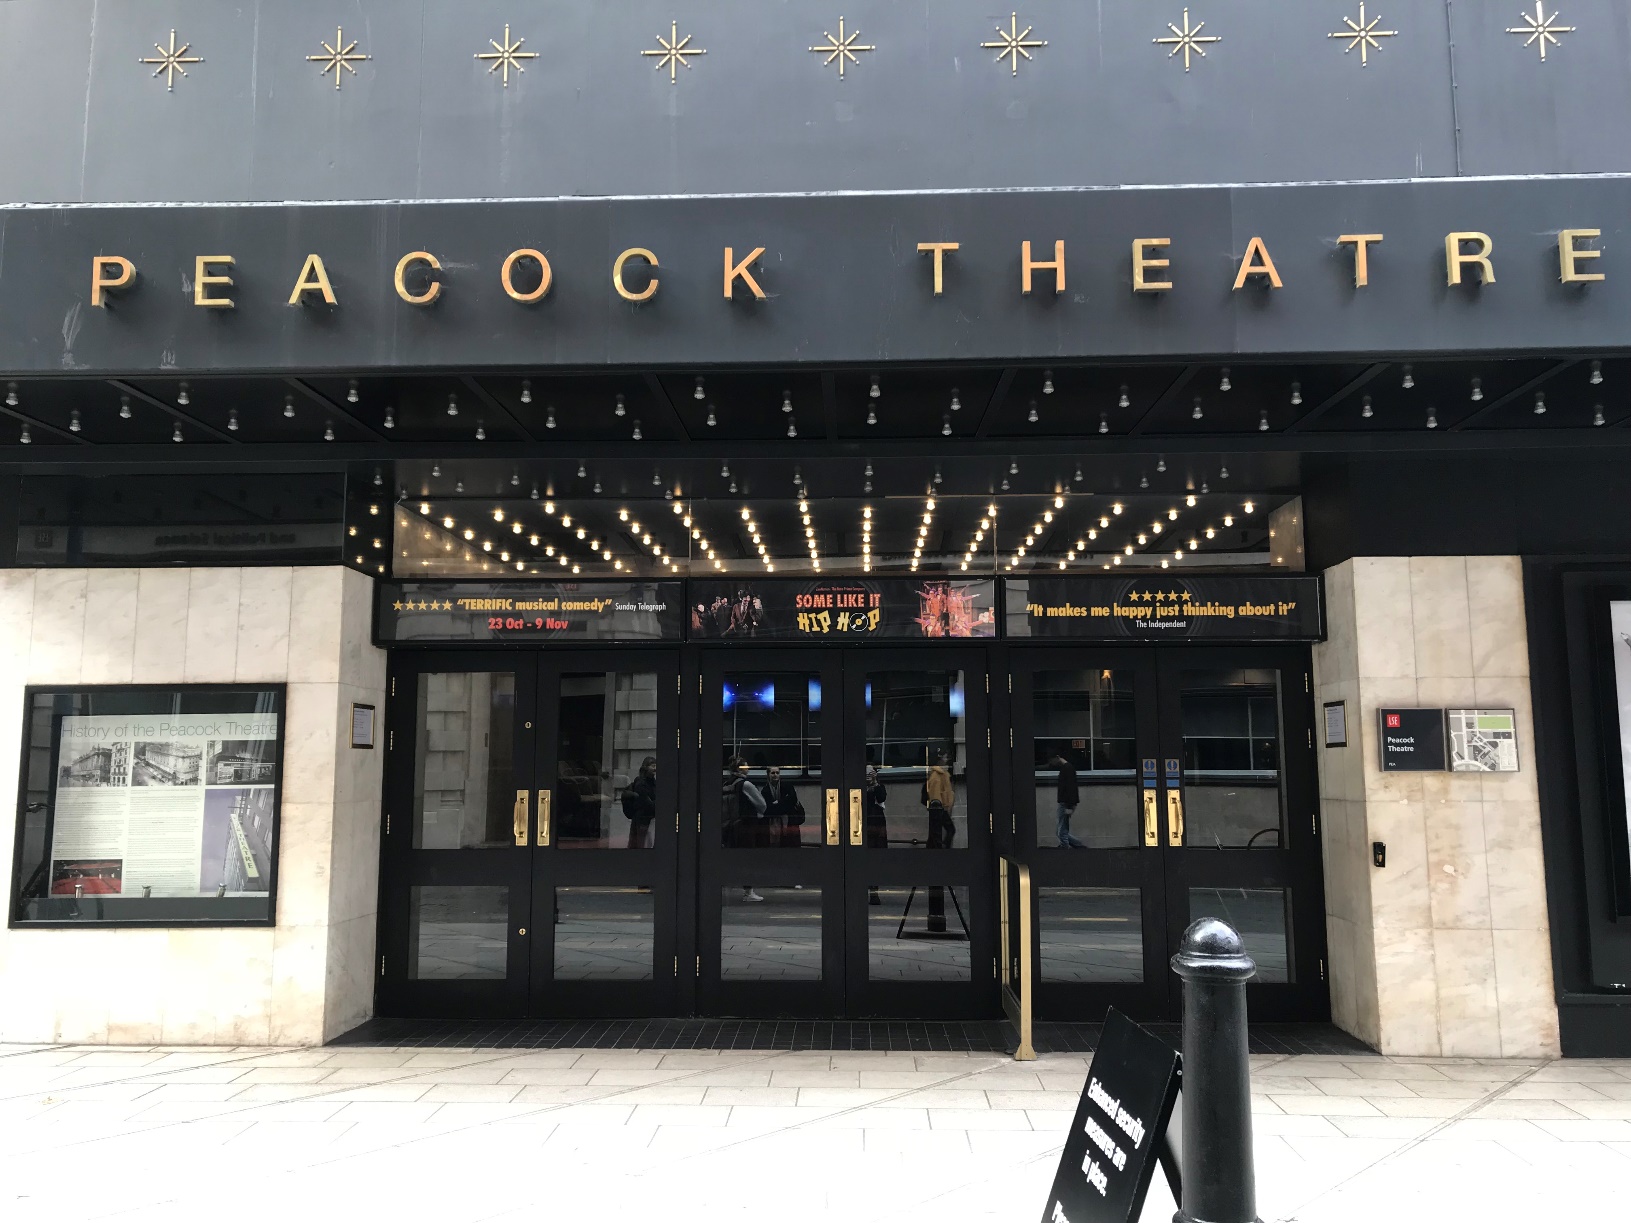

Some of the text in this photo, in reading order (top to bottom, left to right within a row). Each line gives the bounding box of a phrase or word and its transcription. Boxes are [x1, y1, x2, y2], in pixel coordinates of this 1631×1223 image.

[92, 229, 1606, 309] PEACOCK THEATRE
[515, 598, 558, 611] musical
[614, 602, 637, 612] Sunday
[638, 602, 667, 612] Telegraph
[796, 592, 881, 609] SOME LIKE IT
[1047, 604, 1087, 617] makes
[1091, 606, 1110, 617] me
[1114, 603, 1152, 619] happy
[1156, 603, 1179, 618] just
[1183, 602, 1235, 618] thinking
[1238, 602, 1275, 616] about
[488, 618, 503, 629] 23
[506, 618, 524, 629] Oct
[536, 618, 543, 629] 9
[546, 618, 569, 629] Nov
[797, 609, 881, 634] HIP HOP
[1135, 620, 1186, 630] The Independent
[1388, 716, 1398, 726] LSE
[61, 721, 277, 740] History of the Peacock Theatre
[1387, 736, 1415, 744] Peacock
